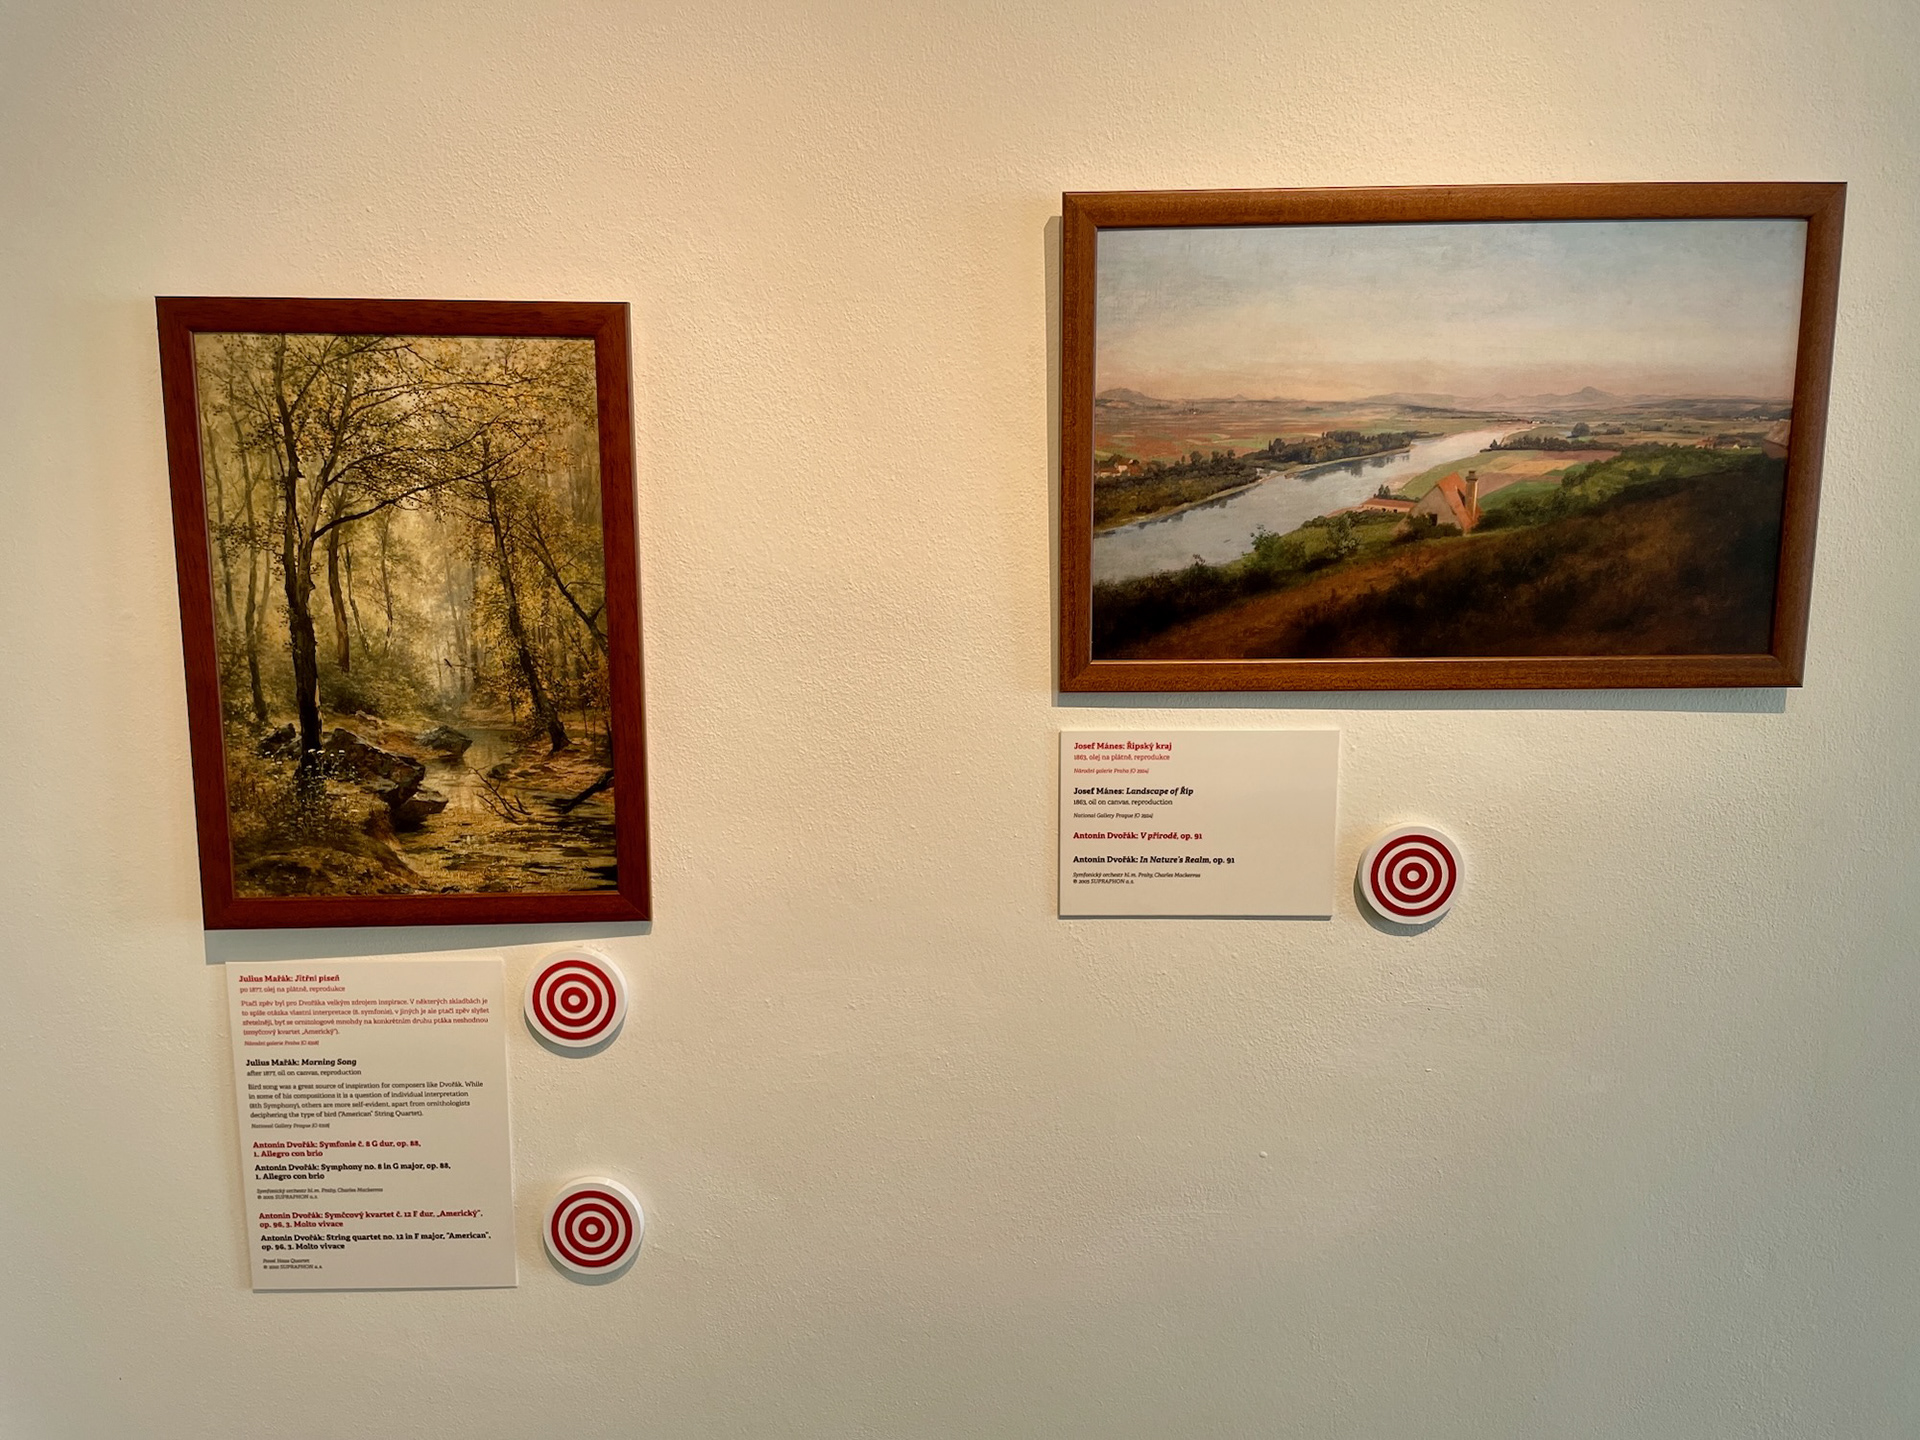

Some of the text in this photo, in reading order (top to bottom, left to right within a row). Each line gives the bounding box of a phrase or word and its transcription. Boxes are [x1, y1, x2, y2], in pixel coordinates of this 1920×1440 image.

[1156, 742, 1172, 751] kraj
[1126, 788, 1169, 796] Landscape
[1170, 788, 1179, 796] of
[310, 985, 346, 993] reprodukce
[302, 1058, 335, 1067] Morning
[337, 1058, 357, 1067] Song
[322, 1069, 362, 1077] reproduction
[320, 1140, 356, 1149] Symfonie
[261, 1150, 290, 1159] Allegro
[321, 1163, 363, 1172] Symphony
[263, 1173, 292, 1182] Allegro
[327, 1234, 351, 1242] String
